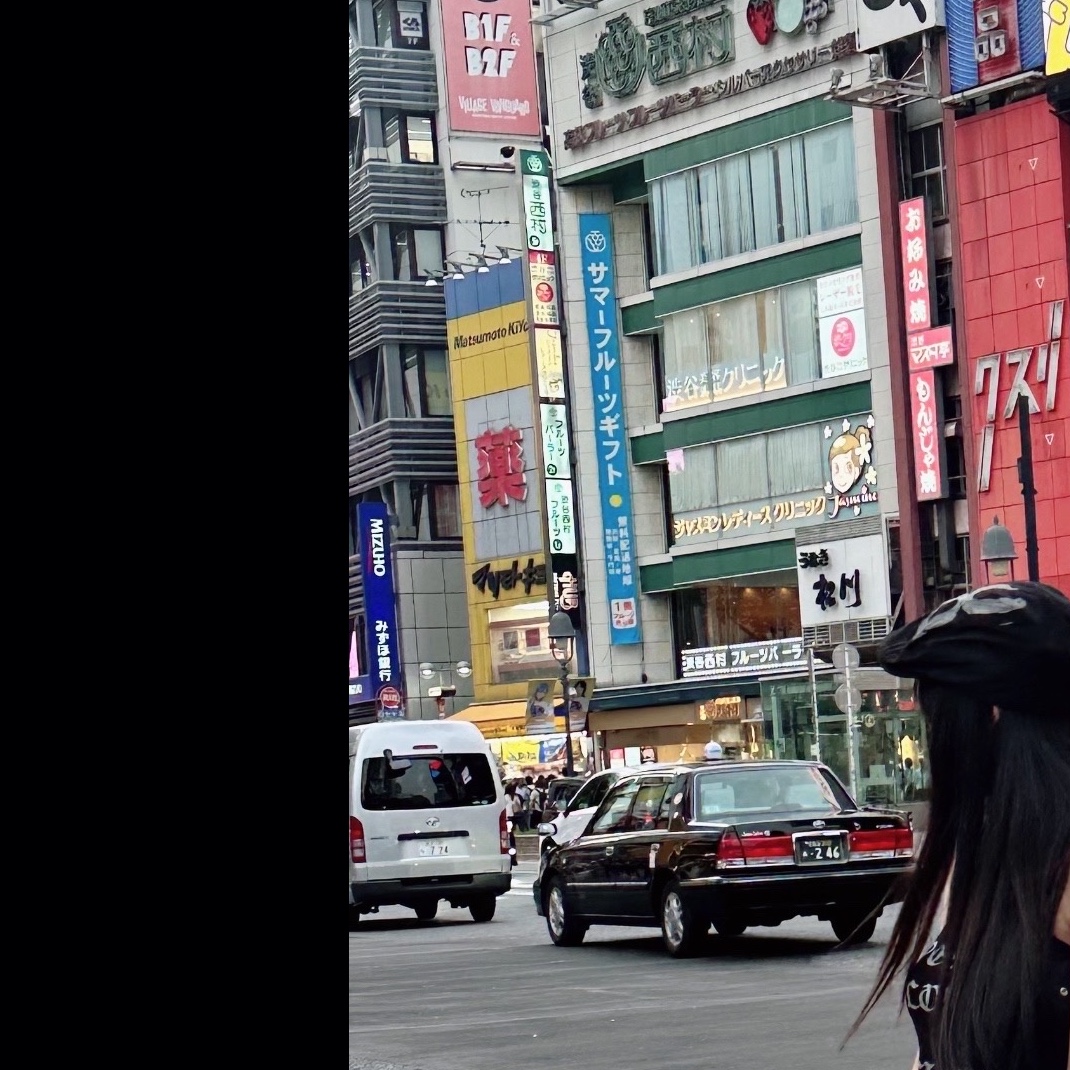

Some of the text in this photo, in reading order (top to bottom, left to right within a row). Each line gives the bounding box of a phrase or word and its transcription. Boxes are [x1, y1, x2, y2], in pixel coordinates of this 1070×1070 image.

[463, 11, 512, 42] B1F
[465, 46, 516, 78] B2F
[905, 207, 926, 324] お好み焼
[453, 327, 507, 350] Matsumoto
[587, 261, 623, 486] サマーフルーツギフト
[915, 376, 937, 494] もんじゃ焼
[474, 425, 528, 508] 薬
[370, 518, 386, 577] MIZUHO
[375, 621, 392, 682] みずほ銀行
